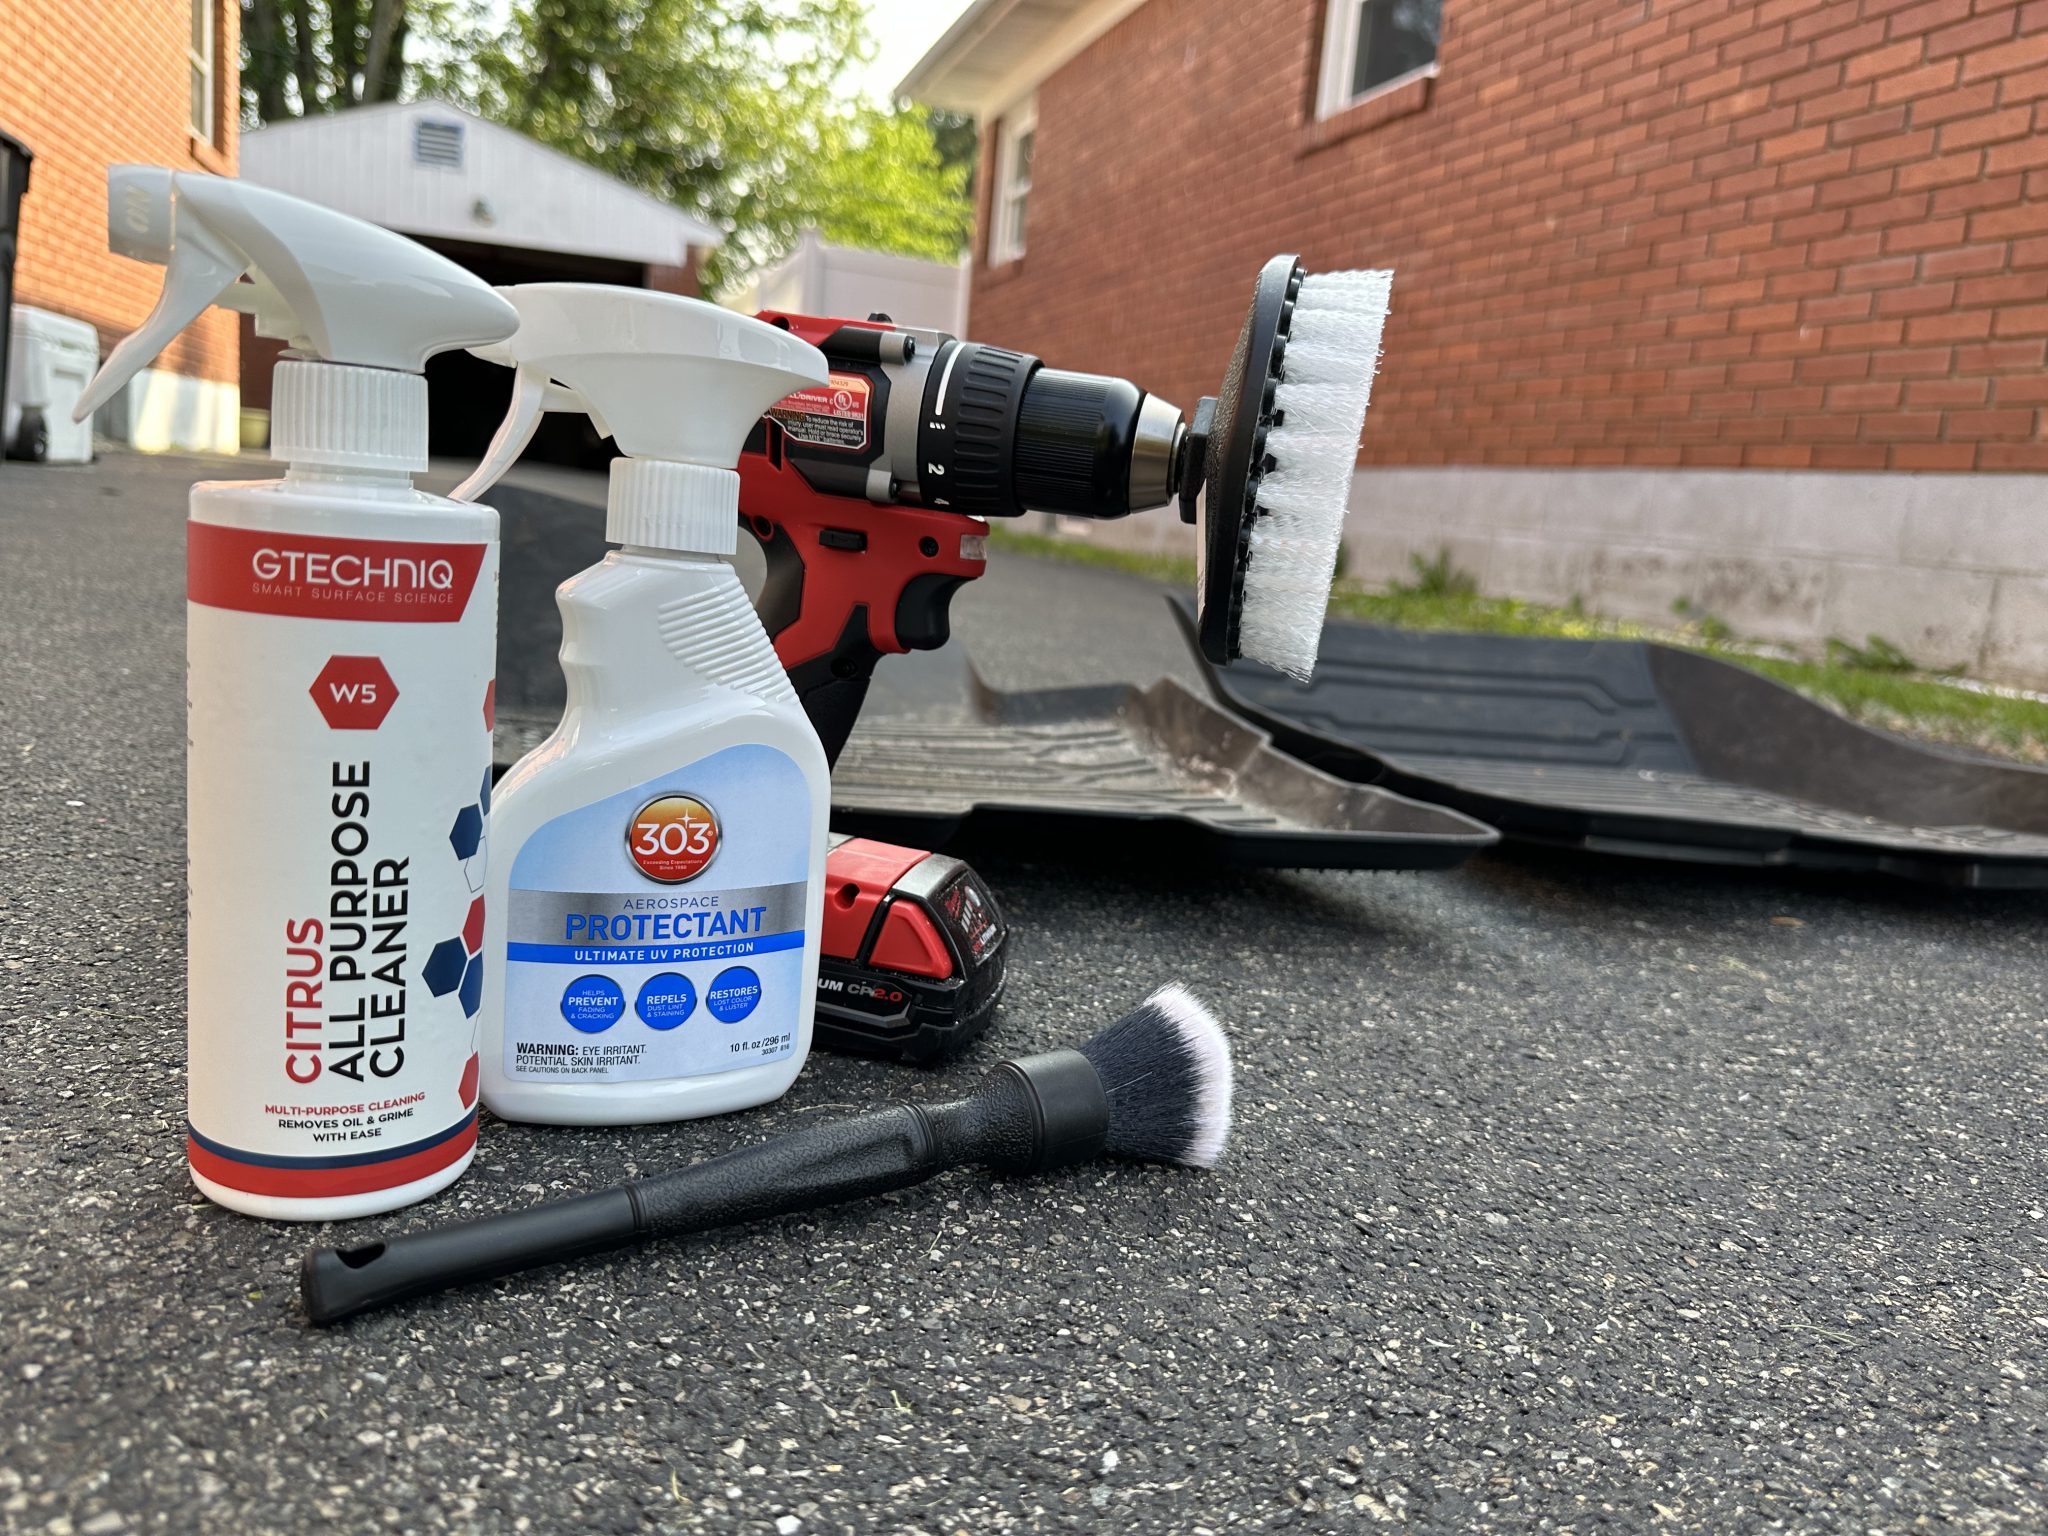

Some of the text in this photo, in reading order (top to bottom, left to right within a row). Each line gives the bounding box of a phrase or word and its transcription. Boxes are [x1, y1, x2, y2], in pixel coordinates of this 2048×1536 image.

[928, 462, 945, 476] 2
[252, 548, 454, 590] GTECHNIQ
[252, 583, 454, 603] SMART SURFACE SCIENCE
[329, 682, 377, 704] W5
[634, 822, 710, 856] 303
[624, 896, 719, 910] AEROSPACE
[328, 760, 371, 1083] ALL PURPOSE
[565, 906, 767, 941] PROTECTANT
[574, 942, 754, 962] ULTIMATE UV PROTECTION
[369, 855, 410, 1079] CLEANER
[817, 978, 844, 992] UM
[646, 994, 687, 1005] REPELS
[710, 986, 758, 1000] RESTORES
[713, 995, 752, 1006] LOST COLOR
[285, 918, 324, 1084] CITRUS
[568, 996, 619, 1006] PREVENT
[647, 1004, 667, 1012] DUST,
[724, 1002, 749, 1011] LUSTER
[516, 1042, 648, 1056] WARNING: EYE IRRITANT.
[730, 1042, 740, 1052] 10
[742, 1041, 750, 1051] fl.
[780, 1032, 791, 1044] ml
[516, 1054, 641, 1066] POTENTIAL SKIN IRRITANT.
[528, 1066, 560, 1074] CAUTIONS
[589, 1066, 608, 1074] PANEL
[265, 1091, 426, 1116] MULTI-PURPOSE CLEANING
[278, 1108, 414, 1129] REMOVES OIL & GRIME
[312, 1127, 382, 1142] WITH EASE
